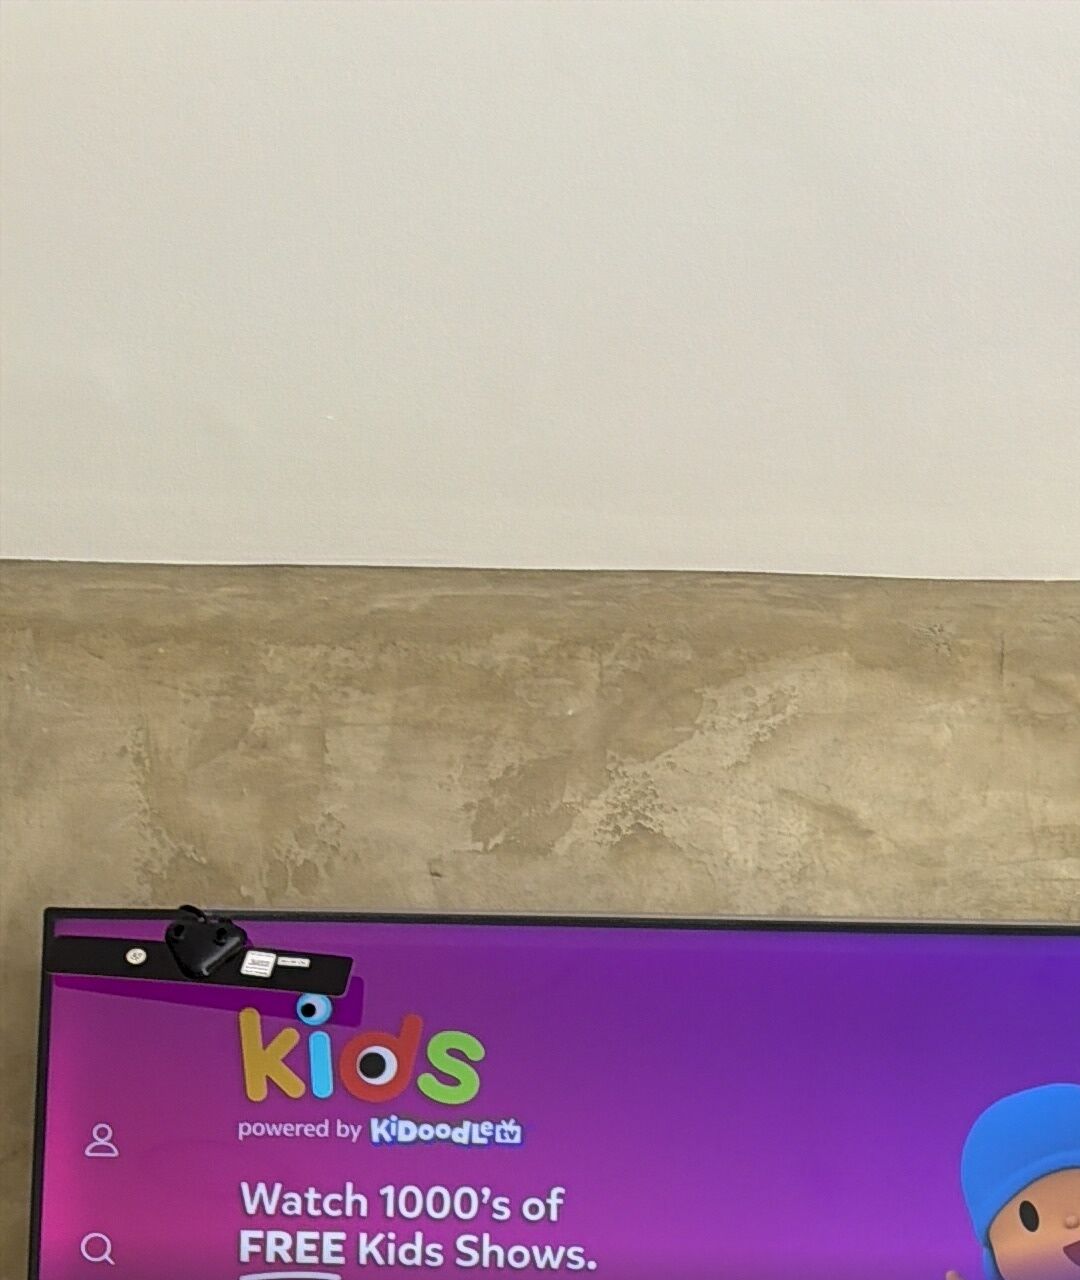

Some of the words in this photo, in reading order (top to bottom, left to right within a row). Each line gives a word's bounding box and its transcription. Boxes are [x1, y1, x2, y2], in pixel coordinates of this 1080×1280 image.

[238, 992, 486, 1105] kids
[238, 1118, 330, 1141] powered
[336, 1119, 362, 1143] by
[240, 1181, 368, 1218] Watch
[379, 1185, 512, 1221] 1000's
[522, 1186, 566, 1222] of
[239, 1229, 347, 1265] FREE
[358, 1230, 445, 1268] Kids
[455, 1232, 598, 1272] Shows.
